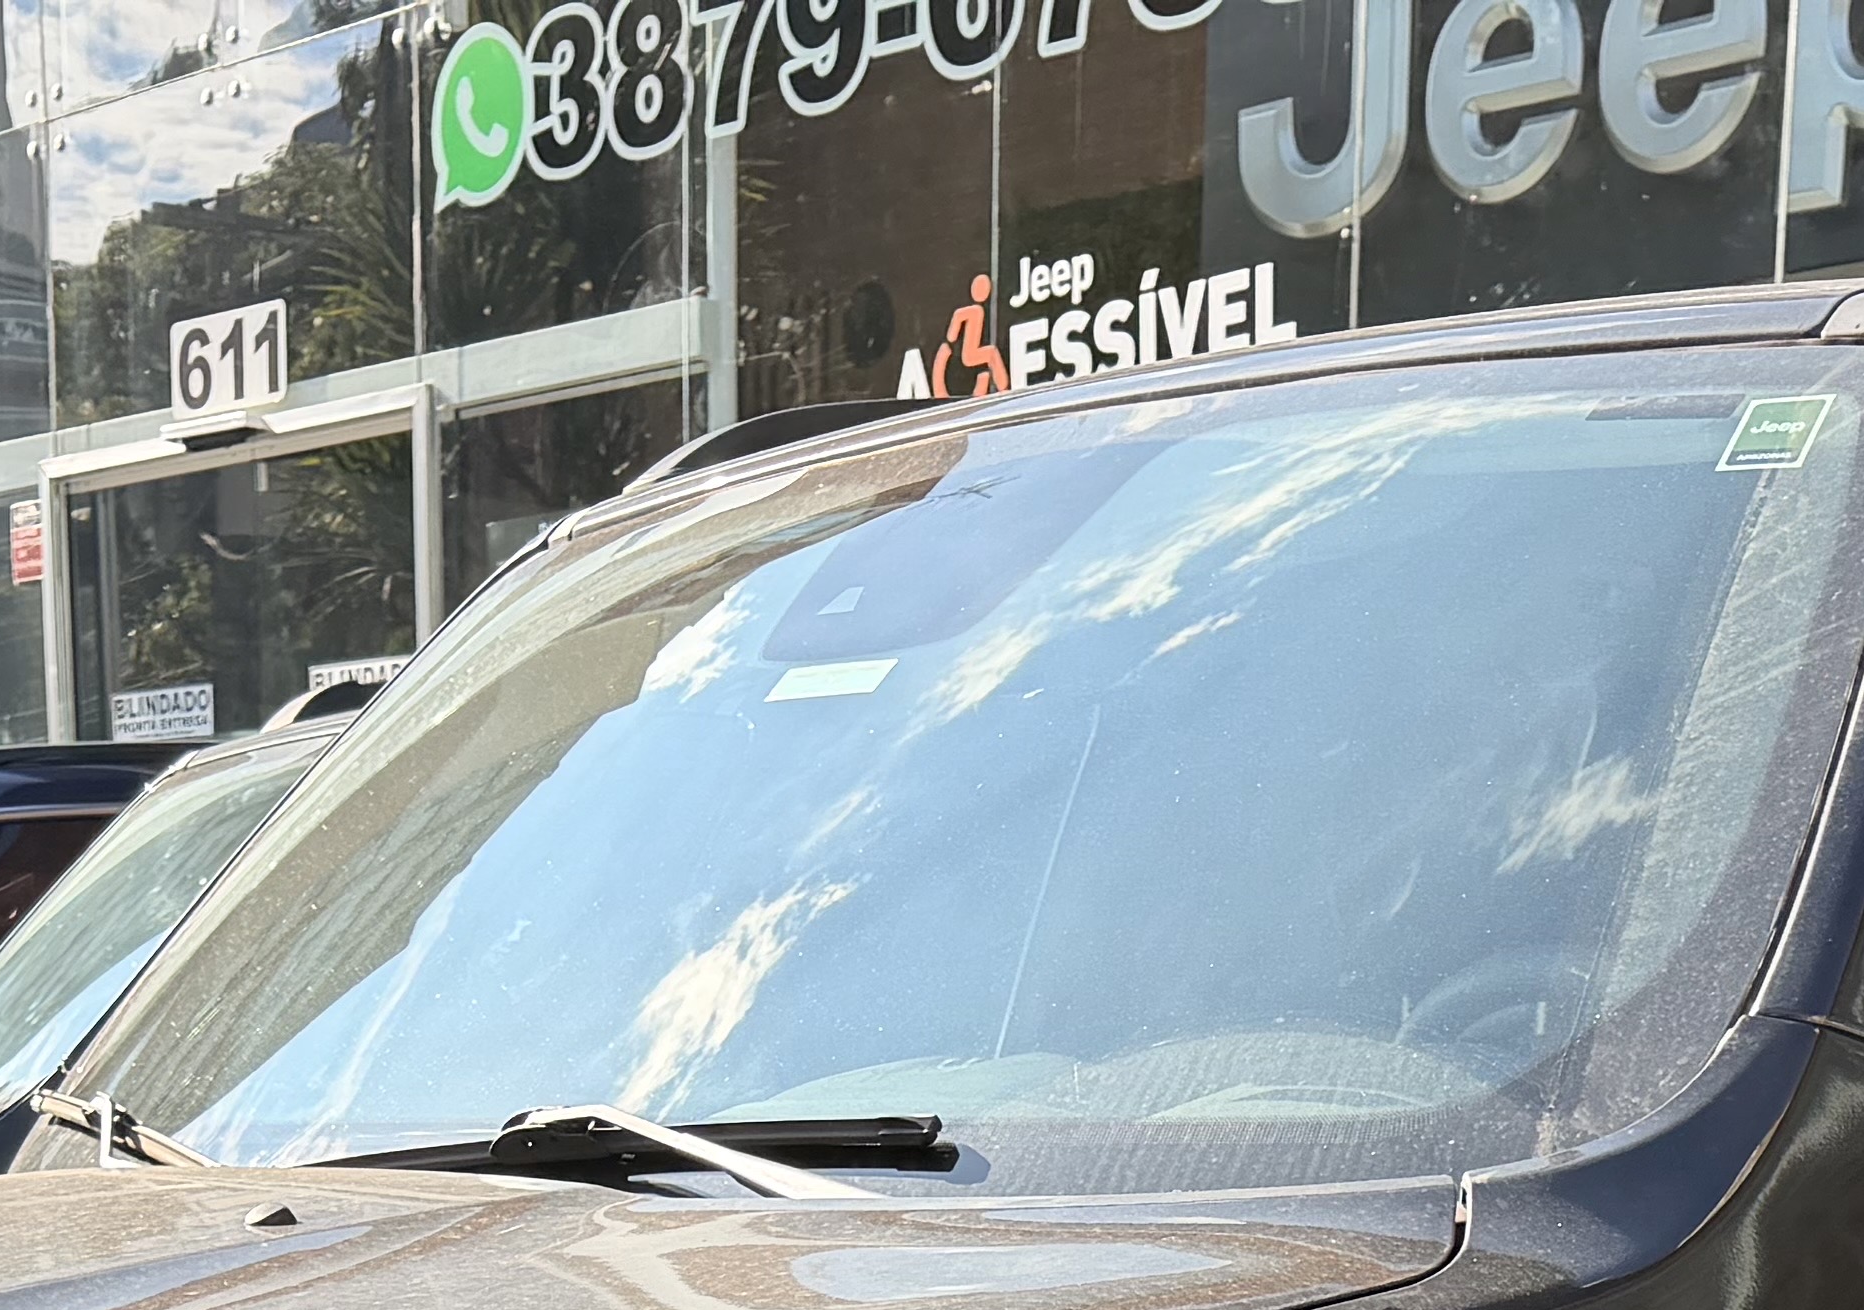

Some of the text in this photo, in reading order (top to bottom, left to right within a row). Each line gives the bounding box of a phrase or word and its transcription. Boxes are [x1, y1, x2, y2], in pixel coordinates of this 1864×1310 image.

[525, 0, 1303, 181] 3879-
[1009, 253, 1094, 306] Jeep
[179, 310, 279, 409] 611
[1749, 420, 1806, 434] Jeep
[115, 689, 209, 719] BLINDADO
